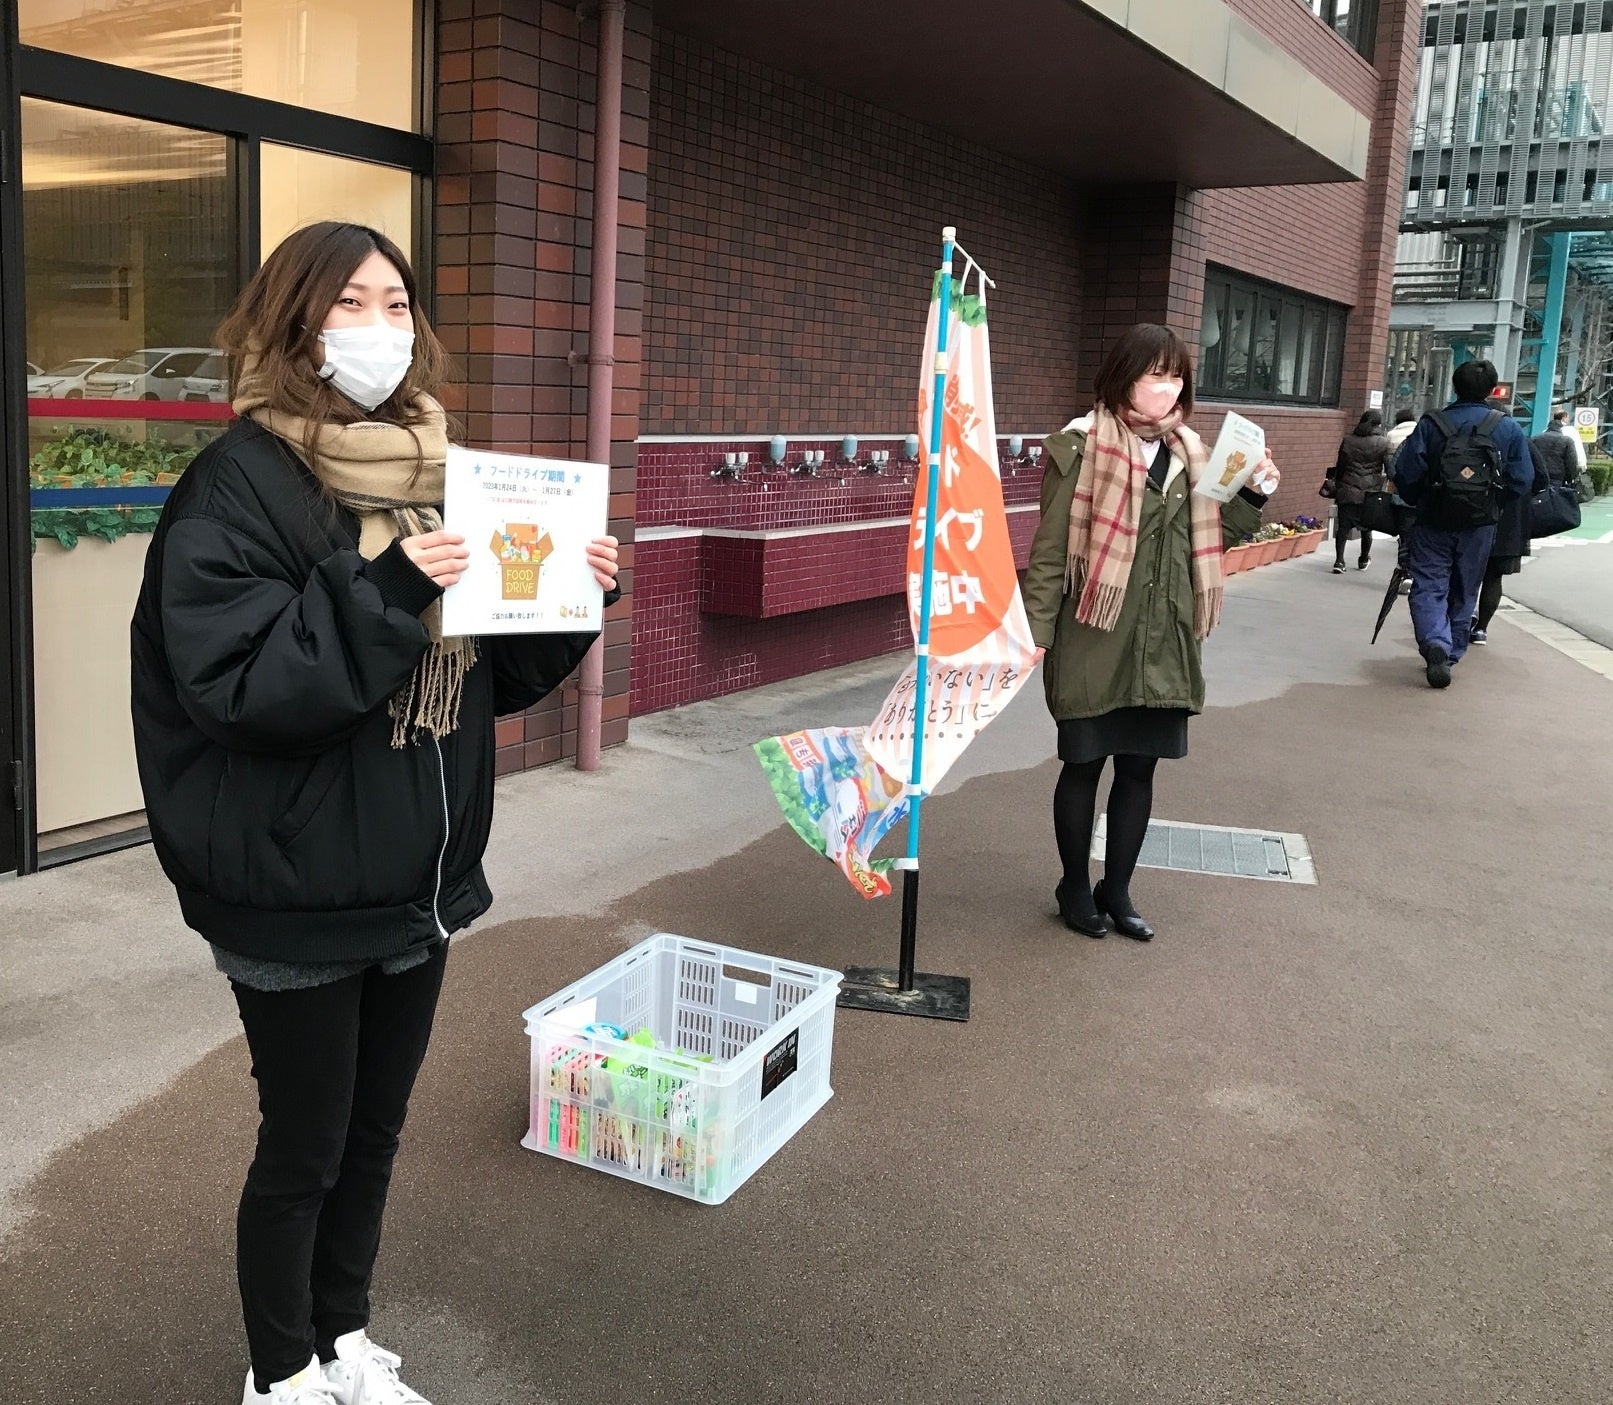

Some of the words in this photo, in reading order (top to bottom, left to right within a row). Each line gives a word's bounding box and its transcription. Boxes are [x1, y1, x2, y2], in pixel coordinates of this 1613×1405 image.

[490, 465, 566, 483] フードドライブ期間
[506, 569, 534, 581] FOOD
[505, 581, 535, 594] DRIVE
